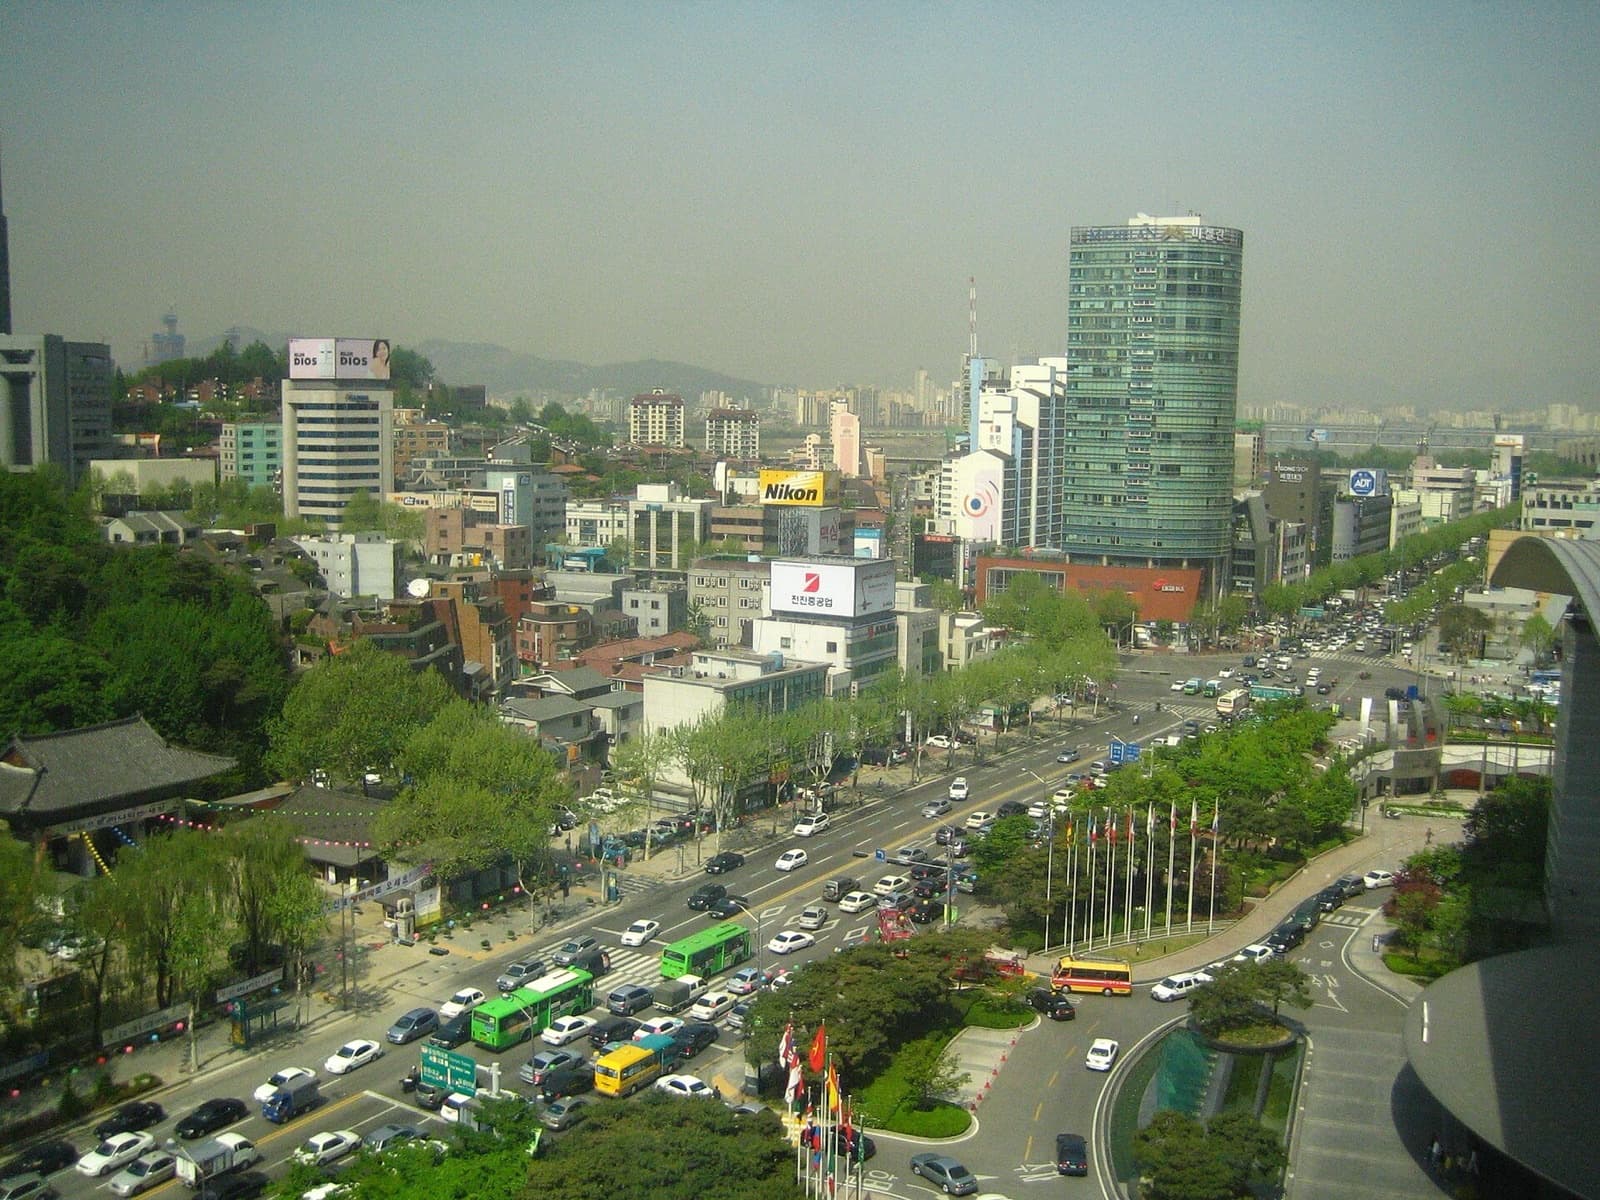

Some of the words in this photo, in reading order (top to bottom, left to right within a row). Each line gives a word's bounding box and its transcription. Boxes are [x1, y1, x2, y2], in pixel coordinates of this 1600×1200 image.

[294, 357, 318, 366] DIOS
[340, 357, 368, 366] DIOS
[1354, 478, 1372, 488] ADT
[765, 483, 818, 501] Nikon
[791, 595, 833, 608] 전진중공업
